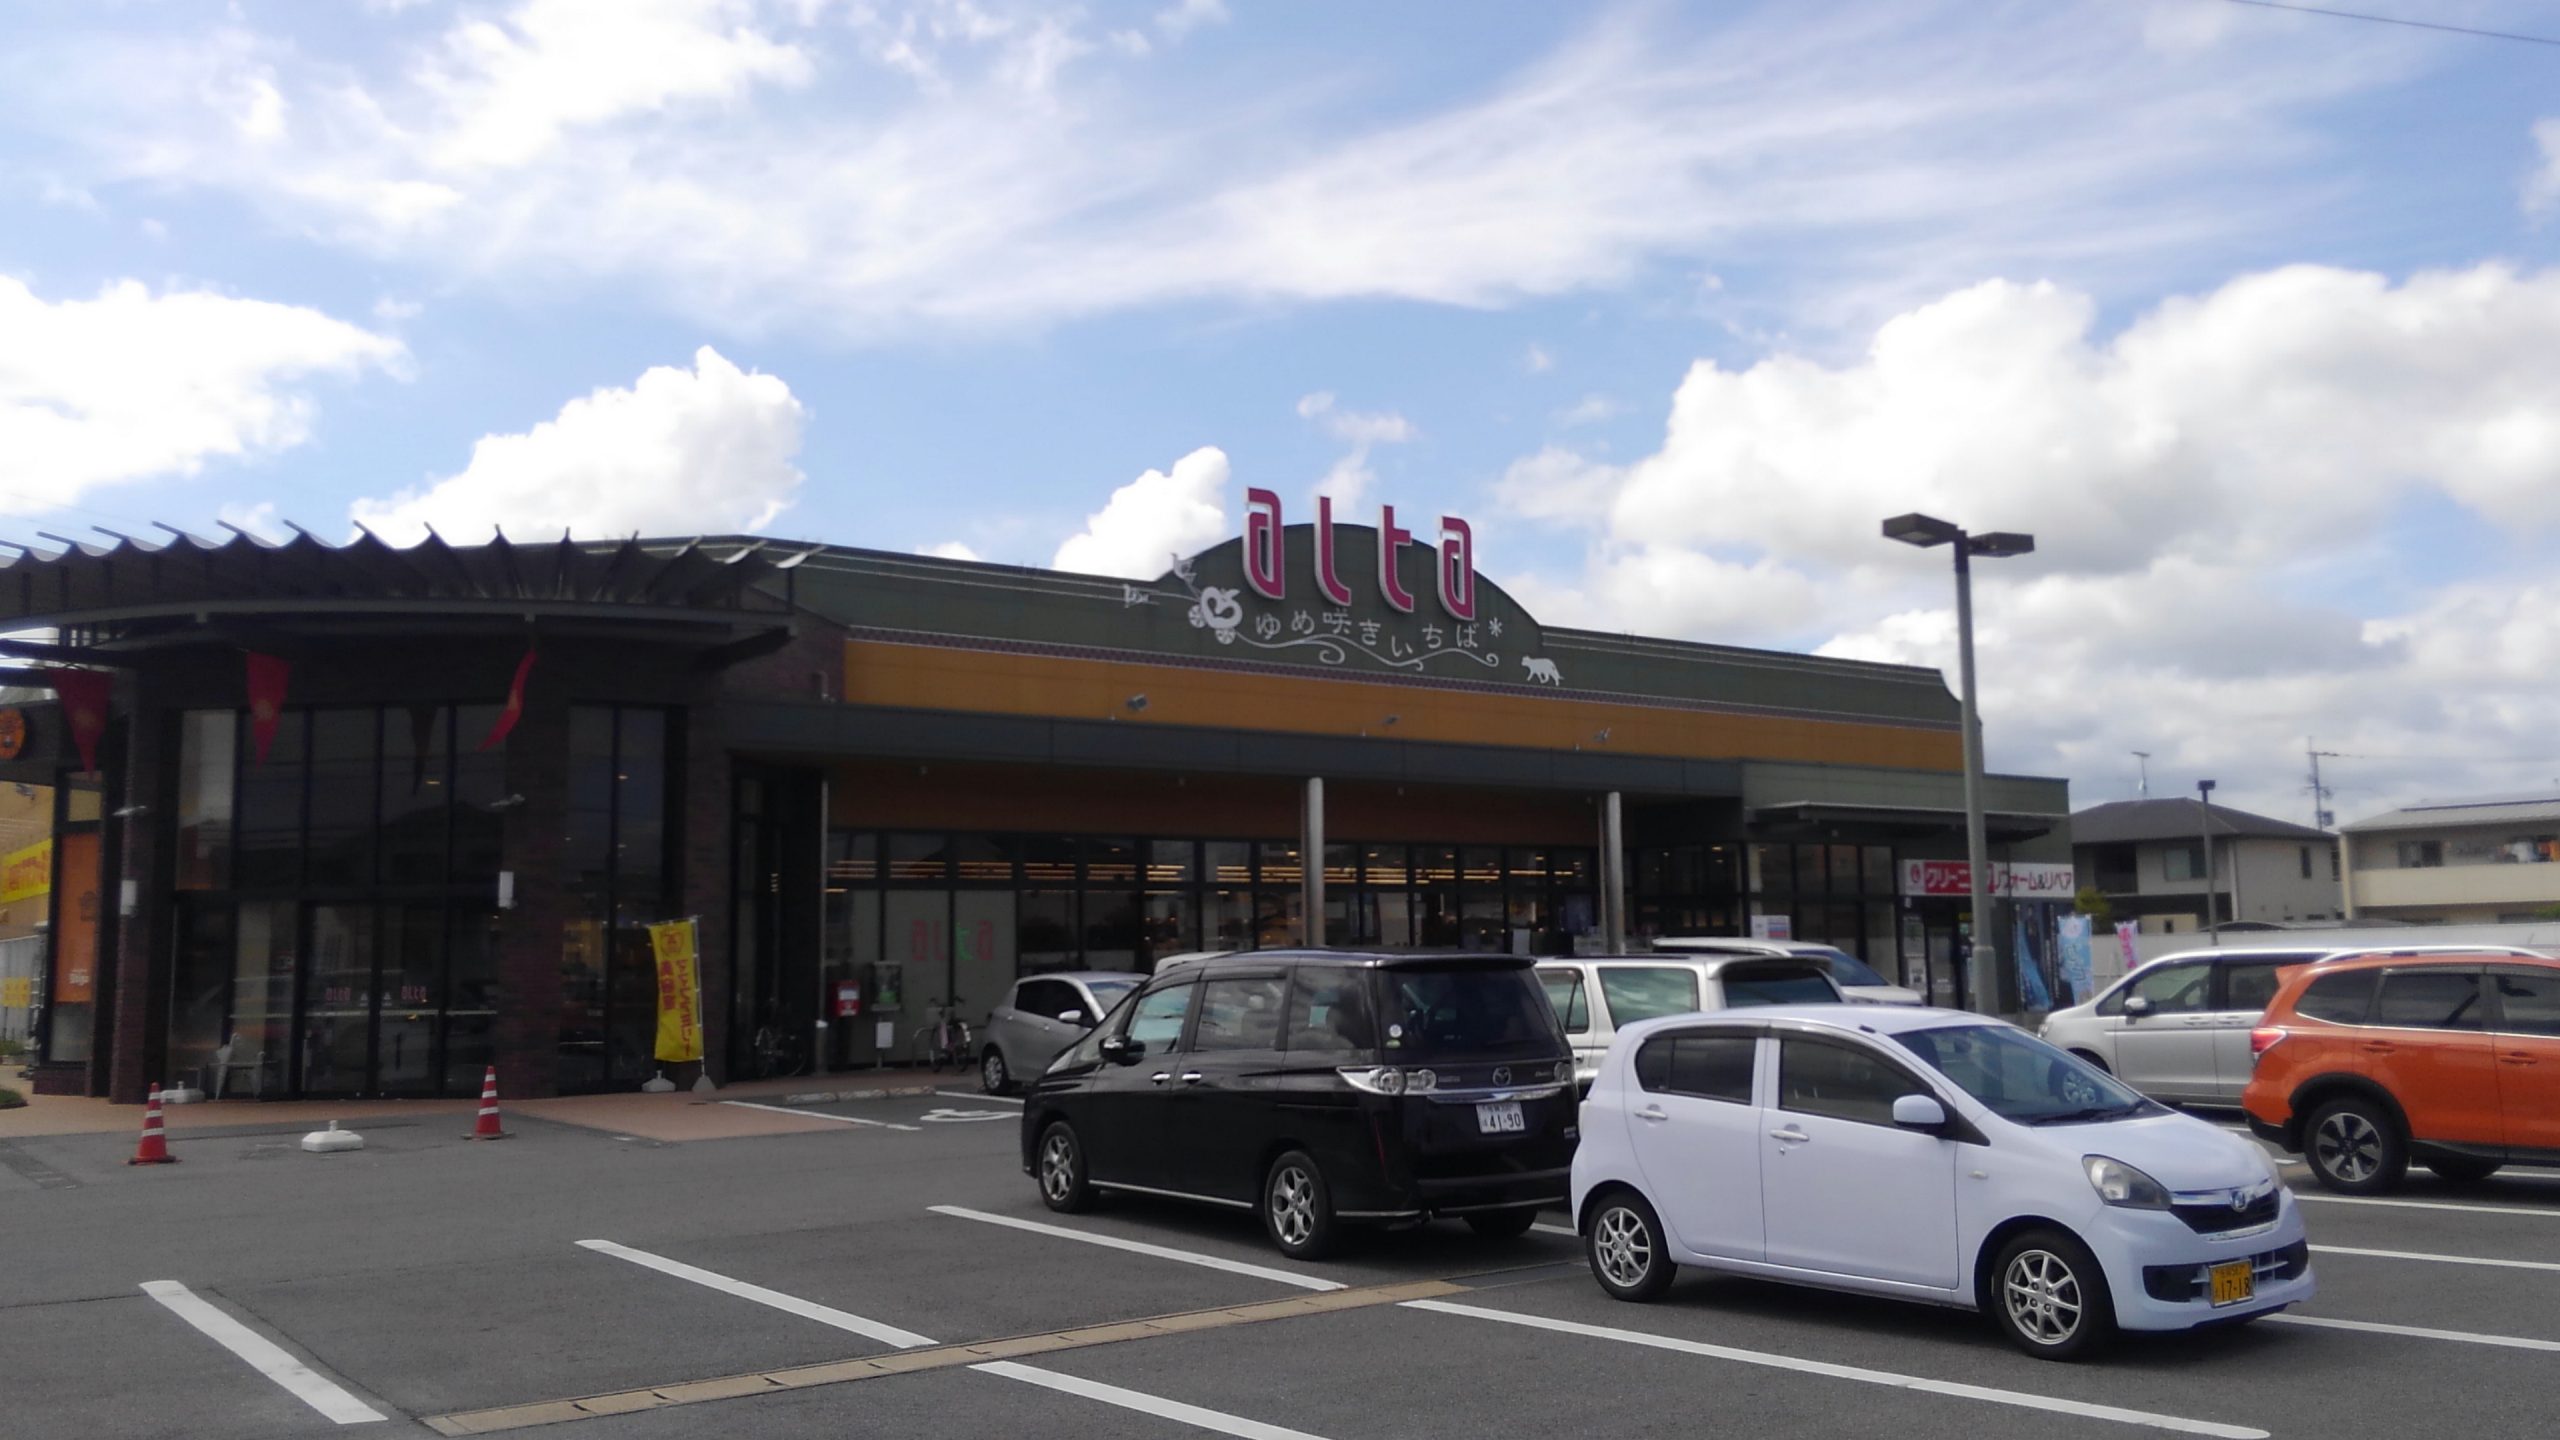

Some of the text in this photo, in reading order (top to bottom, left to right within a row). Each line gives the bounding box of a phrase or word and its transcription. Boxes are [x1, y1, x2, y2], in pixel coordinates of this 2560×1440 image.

[1243, 487, 1476, 620] alta
[1256, 608, 1479, 657] ゆめ咲きいちば
[911, 919, 994, 962] alta
